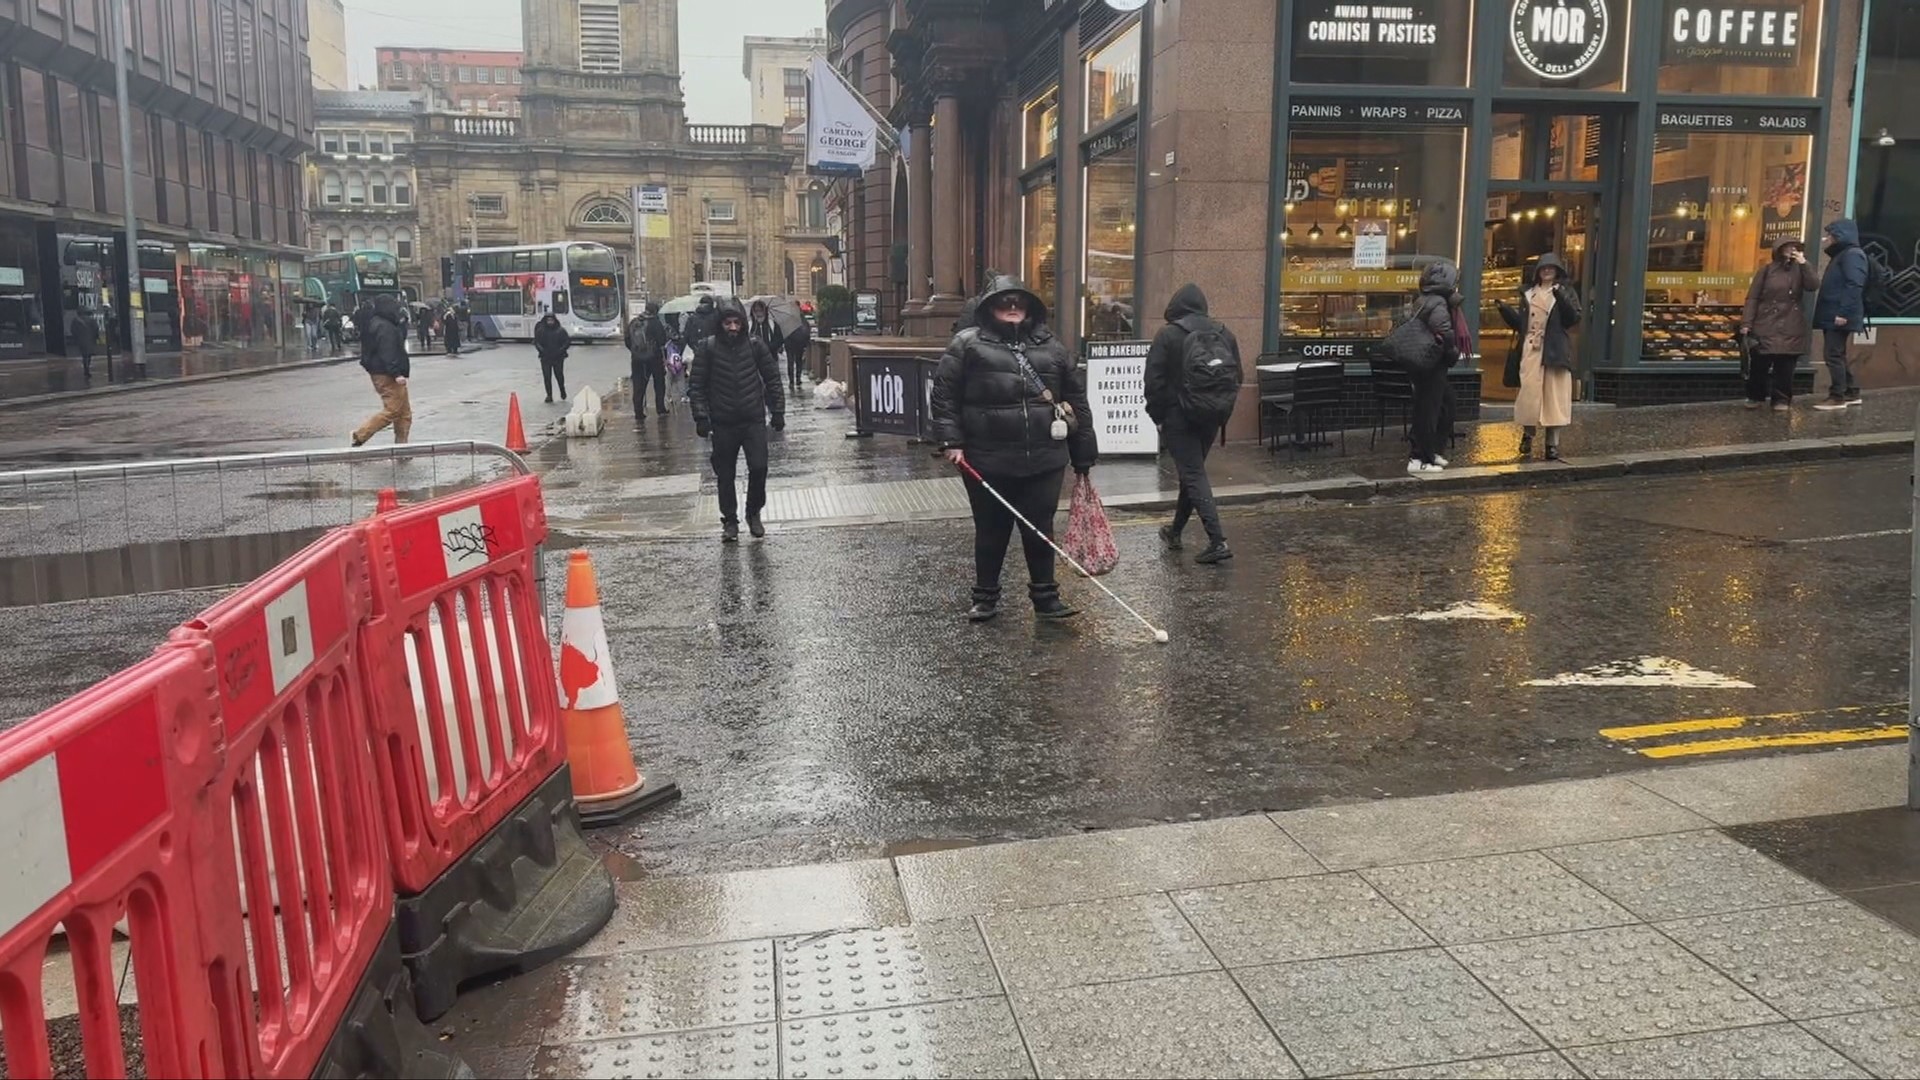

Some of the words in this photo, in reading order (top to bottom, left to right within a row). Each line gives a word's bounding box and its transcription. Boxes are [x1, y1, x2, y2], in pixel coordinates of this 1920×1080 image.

[1334, 5, 1368, 18] AWARD
[1372, 6, 1413, 20] WINNING
[1673, 7, 1798, 46] COFFEE
[1308, 21, 1371, 42] CORNISH
[1378, 23, 1437, 44] PASTIES
[1516, 31, 1539, 65] COFFEE
[1545, 63, 1567, 73] DELI
[1574, 33, 1600, 67] BAKERY
[1291, 105, 1342, 117] PANINIS
[1360, 106, 1407, 118] WRAPS
[1427, 107, 1462, 119] PIZZA
[1661, 113, 1733, 127] BAGUETTES
[1759, 116, 1806, 128] SALADS
[823, 127, 863, 137] CARLTON
[820, 136, 867, 148] GEORGE
[1354, 182, 1394, 190] BARISTA
[1710, 186, 1748, 195] ARTISAN
[1300, 275, 1317, 285] FLAT
[1320, 275, 1343, 285] WHITE
[1358, 275, 1380, 285] LATTE
[1303, 345, 1353, 356] COFFEE
[1105, 366, 1141, 376] PANINIS
[1098, 380, 1143, 390] BAGUETTE
[870, 366, 904, 415] MÒR
[1102, 395, 1145, 405] TOASTIES
[1107, 410, 1139, 419] WRAPS
[1106, 425, 1139, 434] COFFEE
